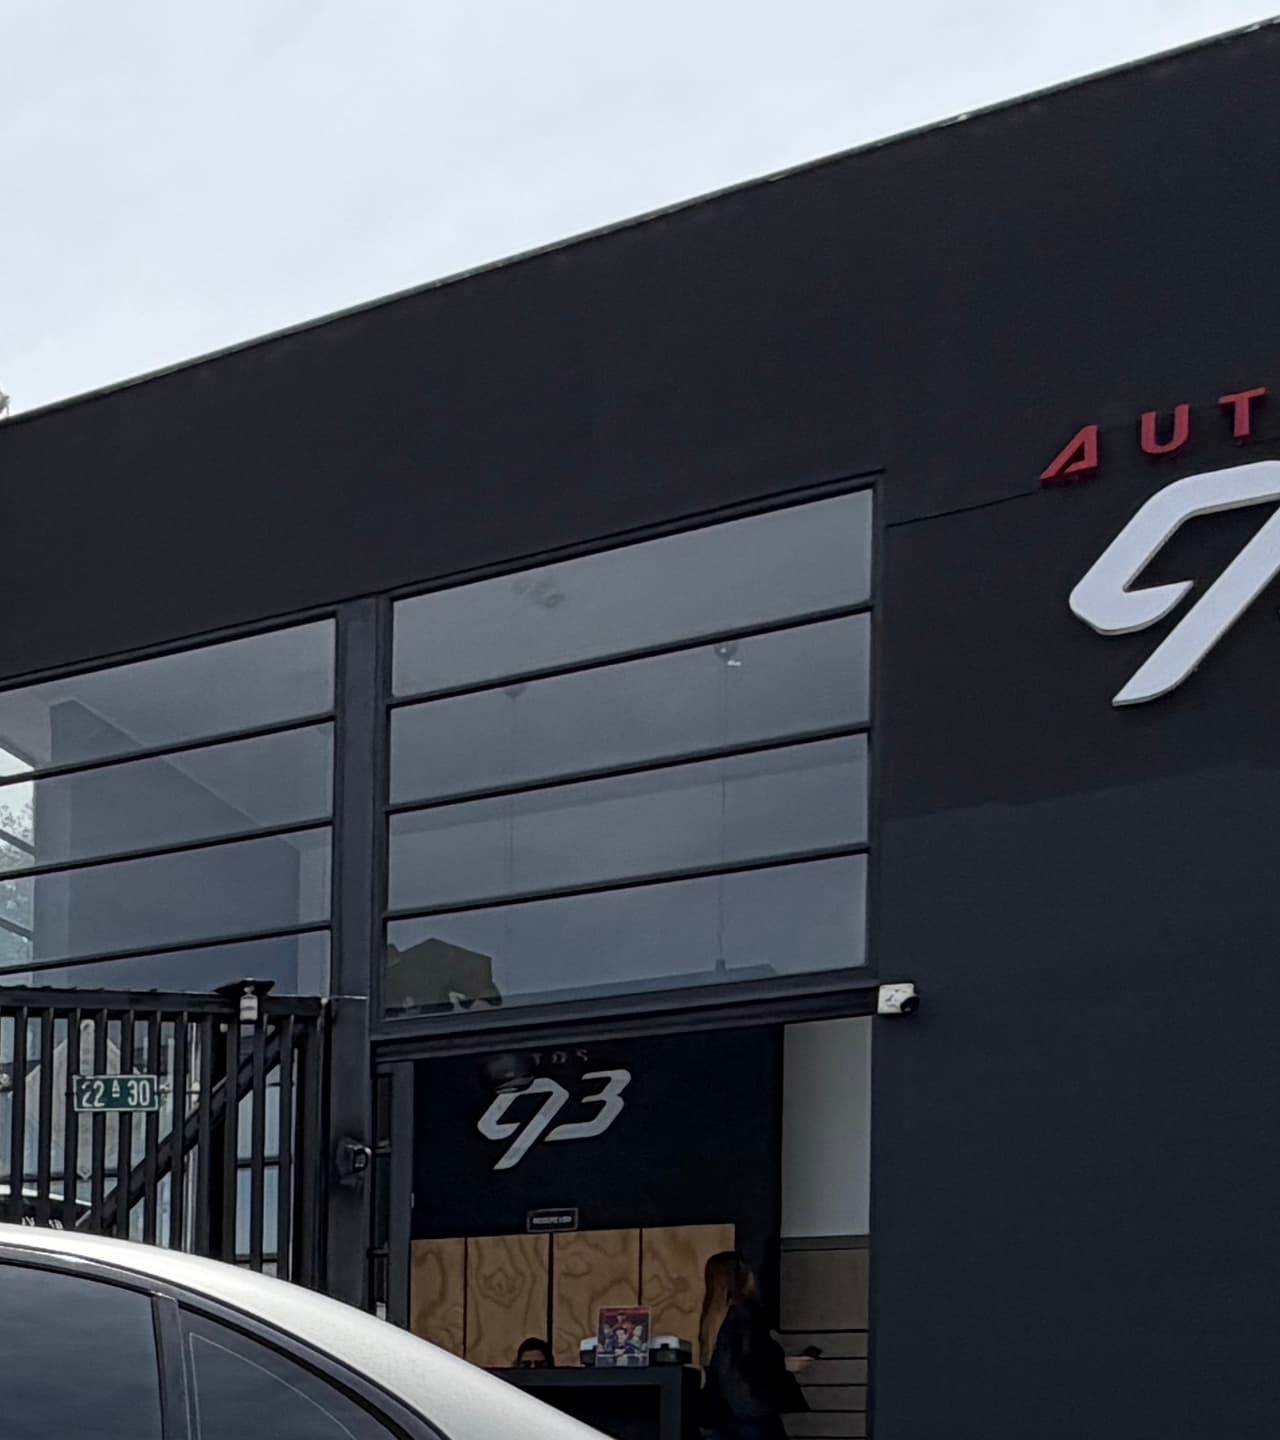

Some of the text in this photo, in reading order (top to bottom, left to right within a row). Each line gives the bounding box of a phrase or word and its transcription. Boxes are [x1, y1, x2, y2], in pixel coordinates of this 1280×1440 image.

[81, 1080, 105, 1107] 22
[127, 1080, 150, 1106] 30
[476, 1068, 632, 1171] 93
